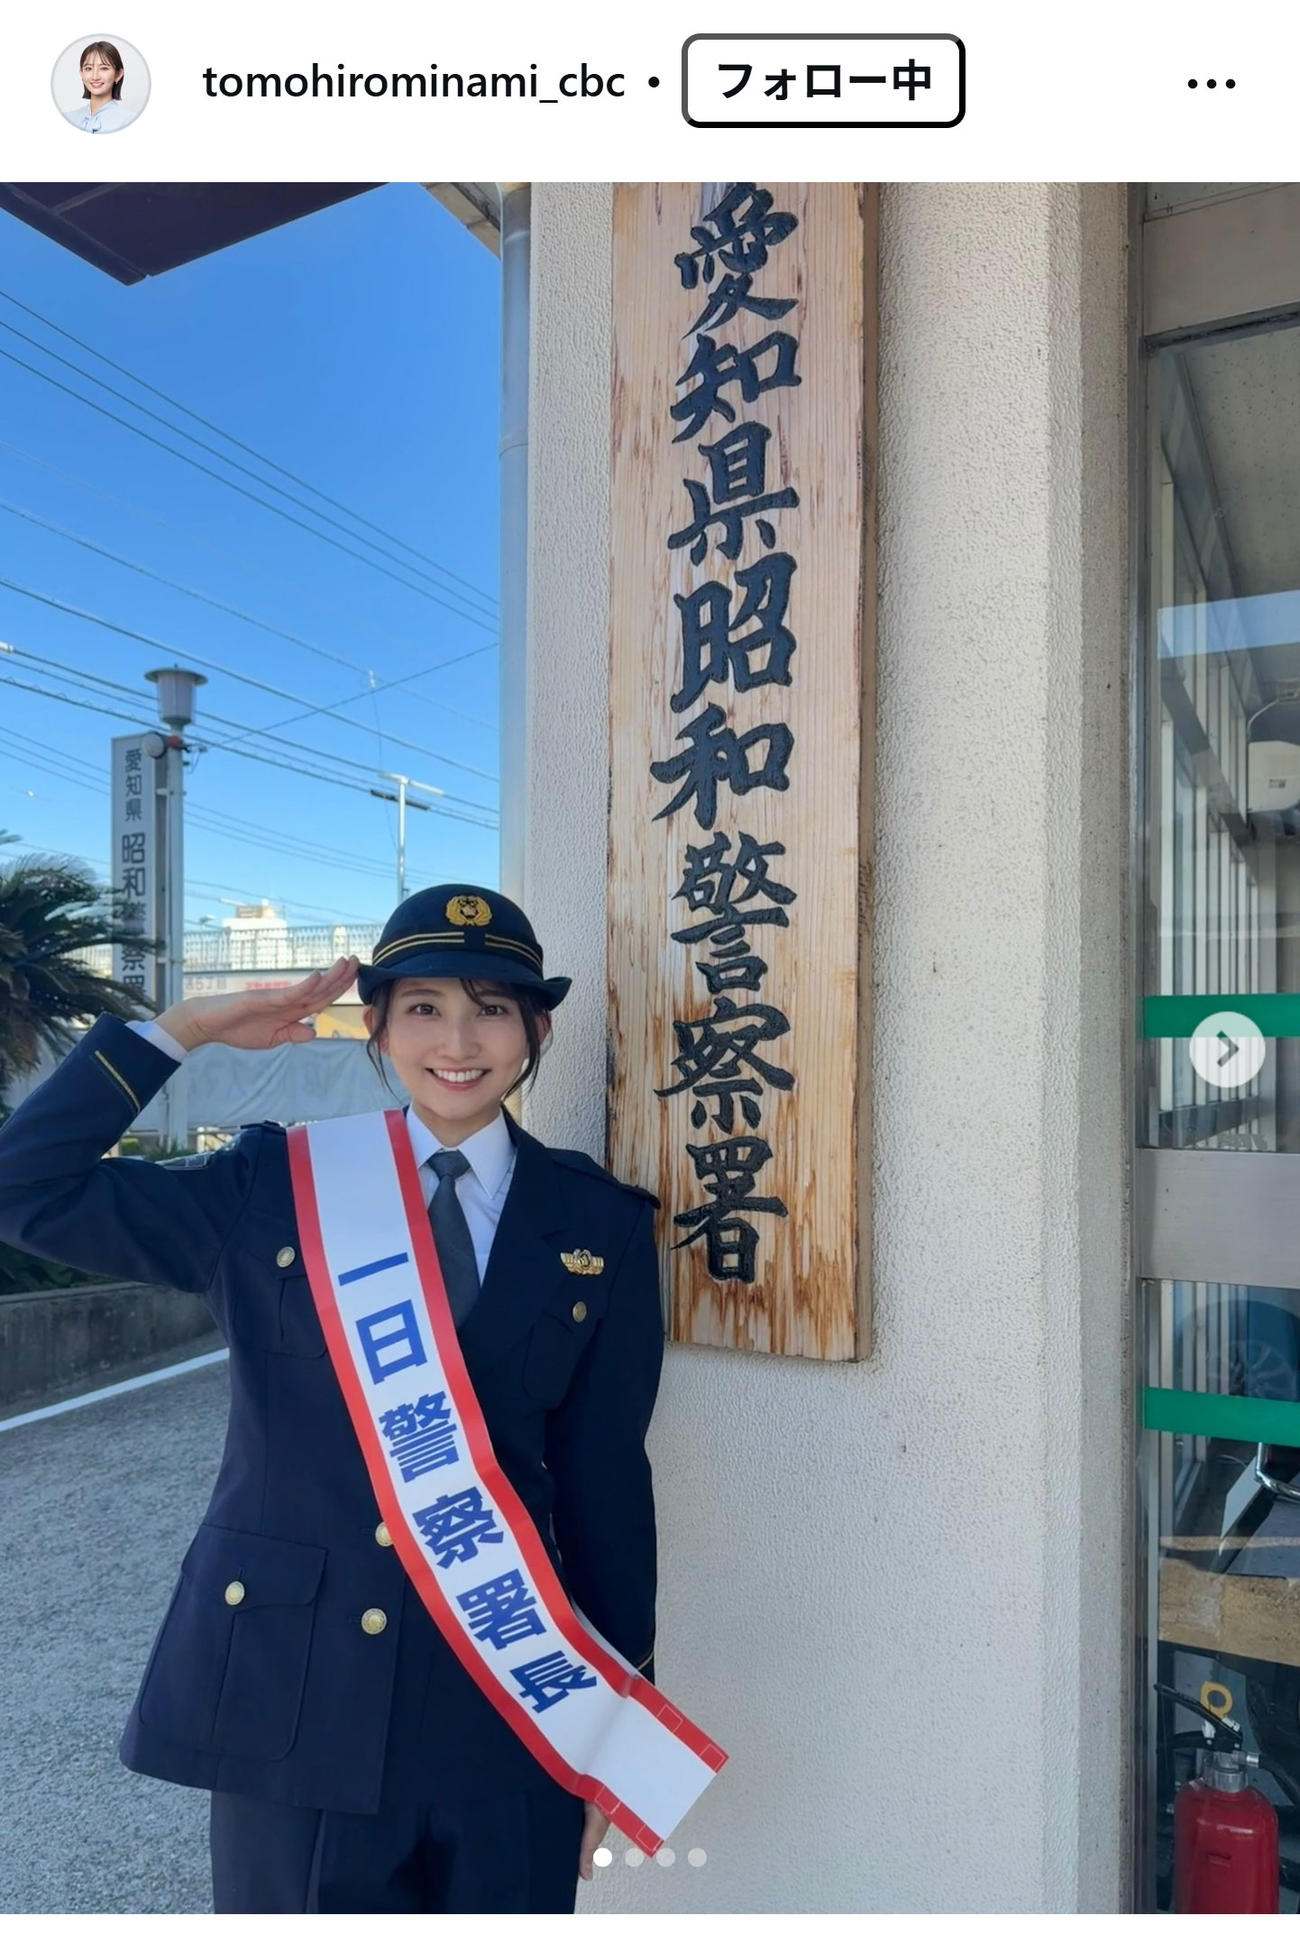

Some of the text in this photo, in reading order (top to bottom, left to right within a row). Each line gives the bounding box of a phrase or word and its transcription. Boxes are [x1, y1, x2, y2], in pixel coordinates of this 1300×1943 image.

[650, 182, 802, 1284] 愛知県昭和警察署
[337, 1251, 598, 1714] 一日警察署長
